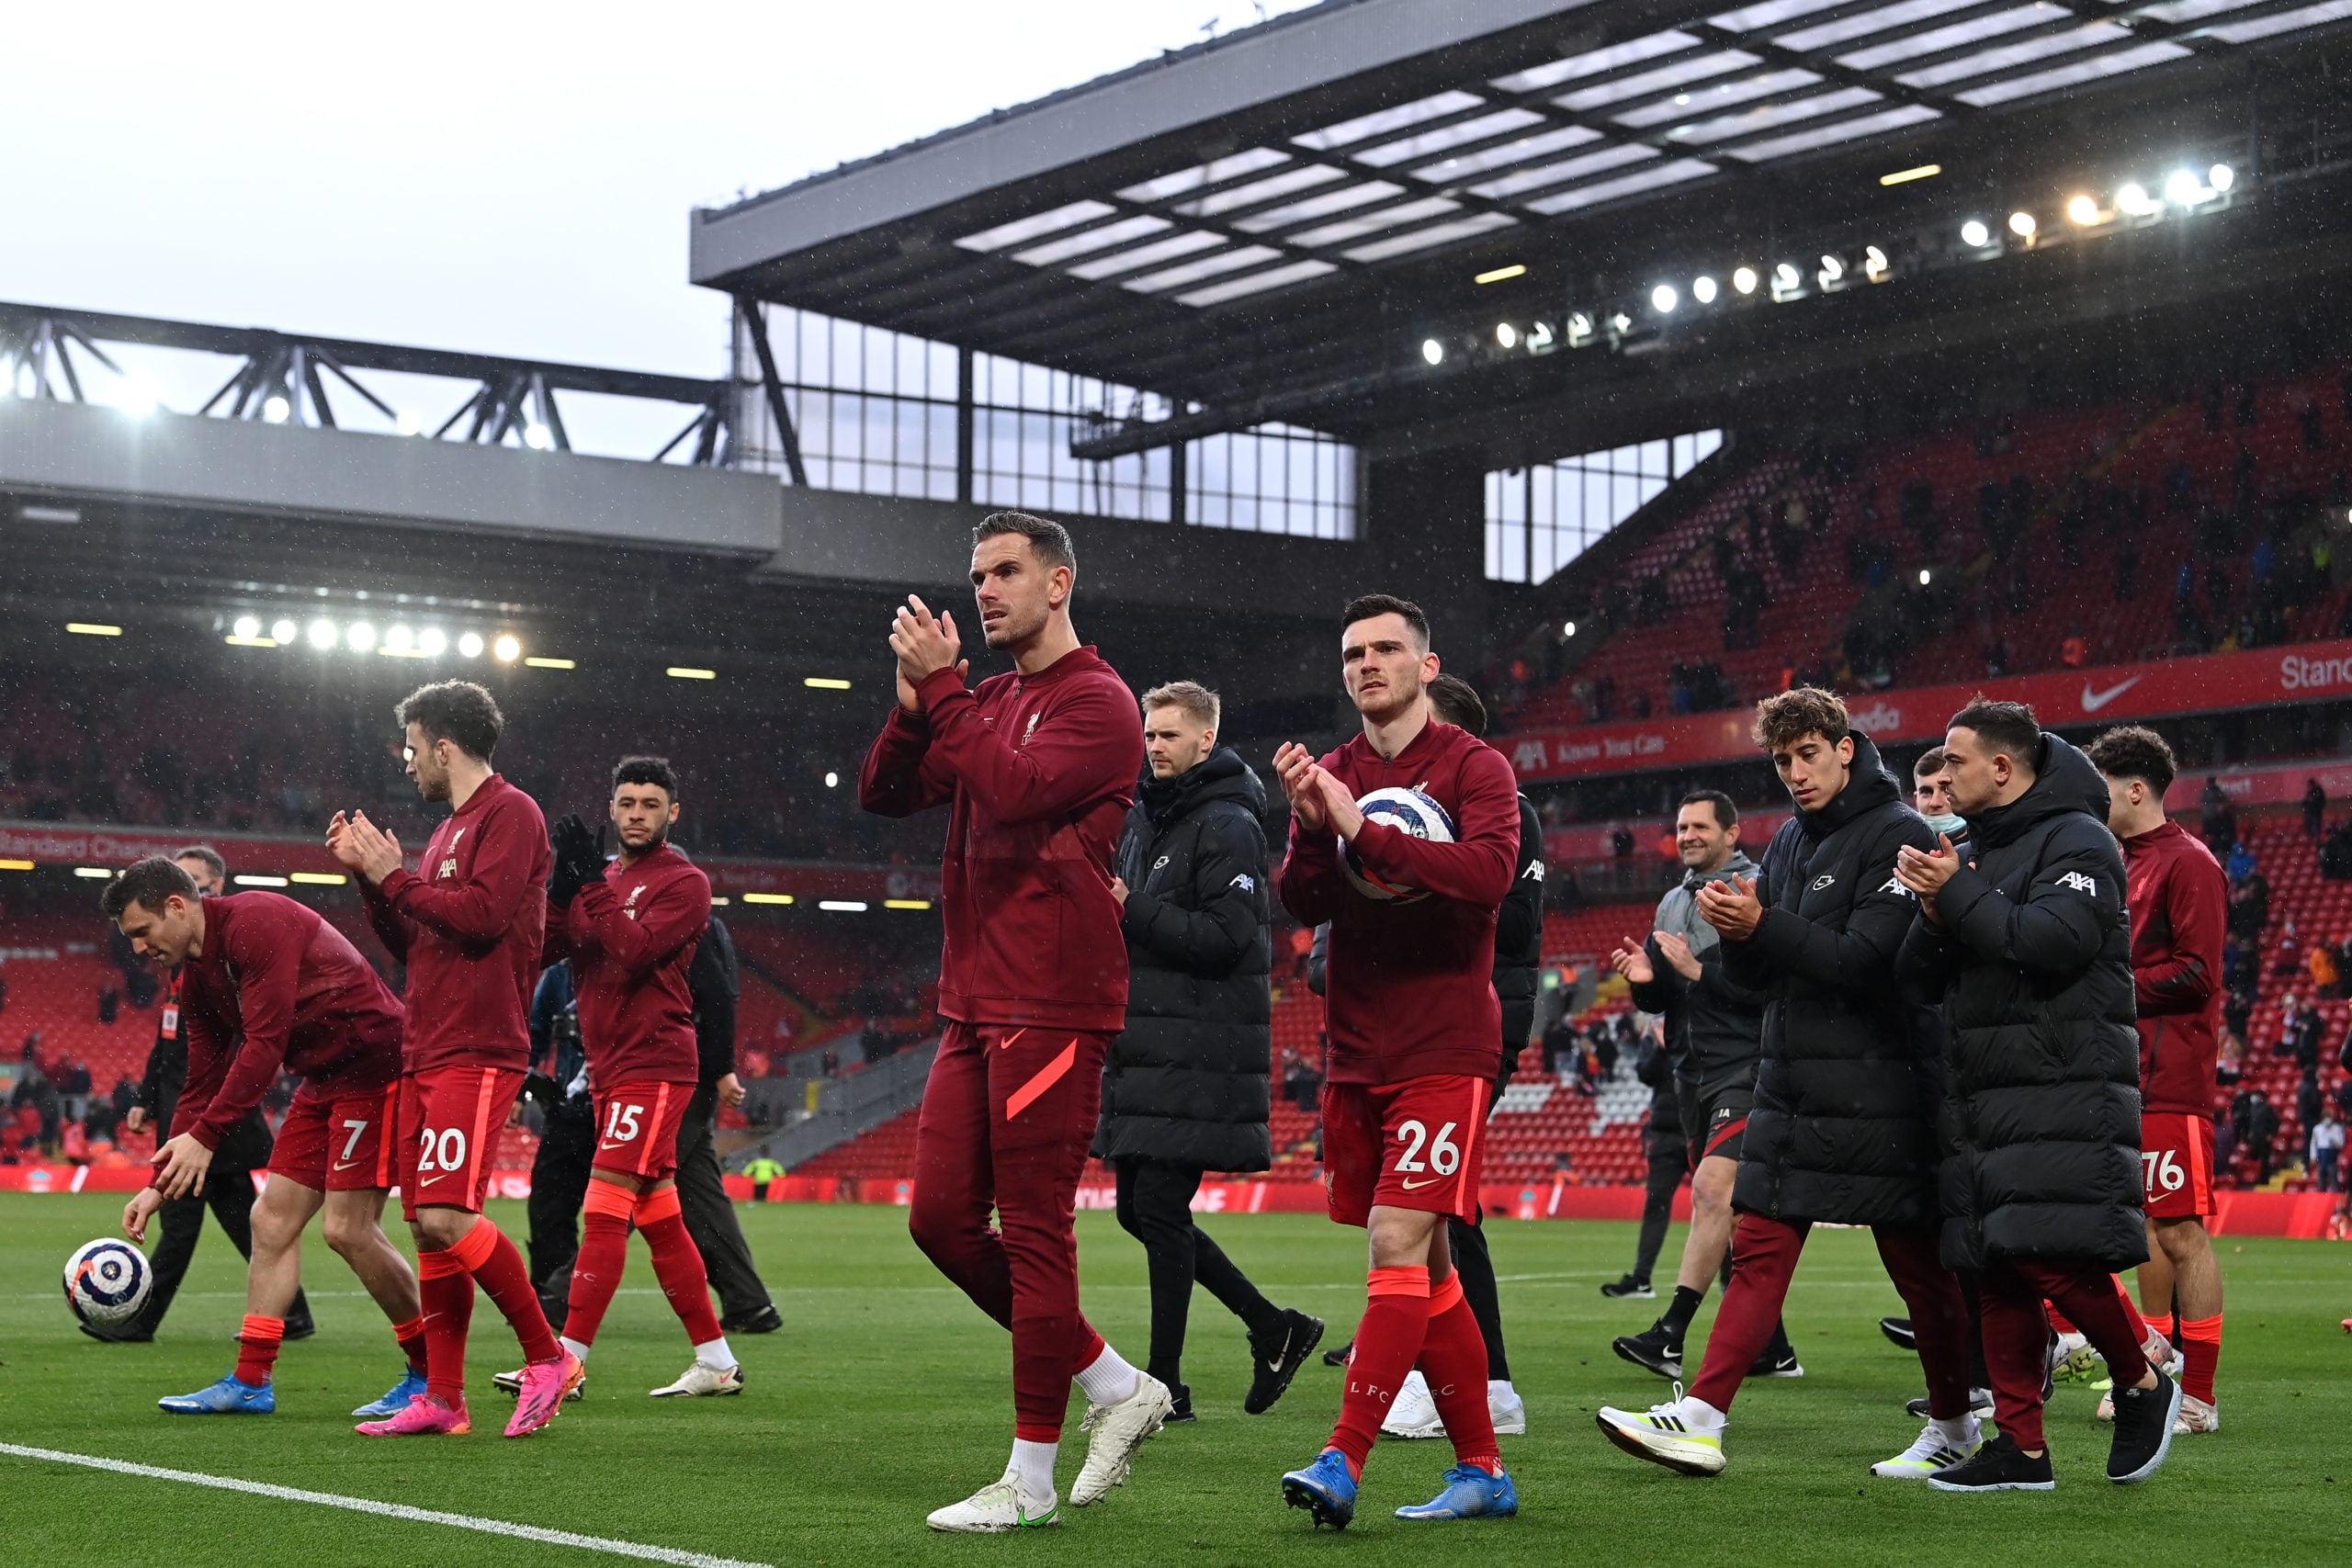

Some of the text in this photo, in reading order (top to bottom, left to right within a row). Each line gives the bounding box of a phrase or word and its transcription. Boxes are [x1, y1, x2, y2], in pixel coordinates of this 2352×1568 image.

[1557, 742, 1600, 763] Know
[1605, 739, 1633, 757] You
[1634, 735, 1665, 754] Can
[435, 859, 458, 881] AXA
[1228, 873, 1254, 895] AXA
[2053, 871, 2096, 897] AXA
[341, 1119, 368, 1161] 7
[606, 1101, 645, 1142] 15
[417, 1127, 467, 1172] 20
[1394, 1119, 1460, 1176] 26
[2141, 1149, 2186, 1191] 76
